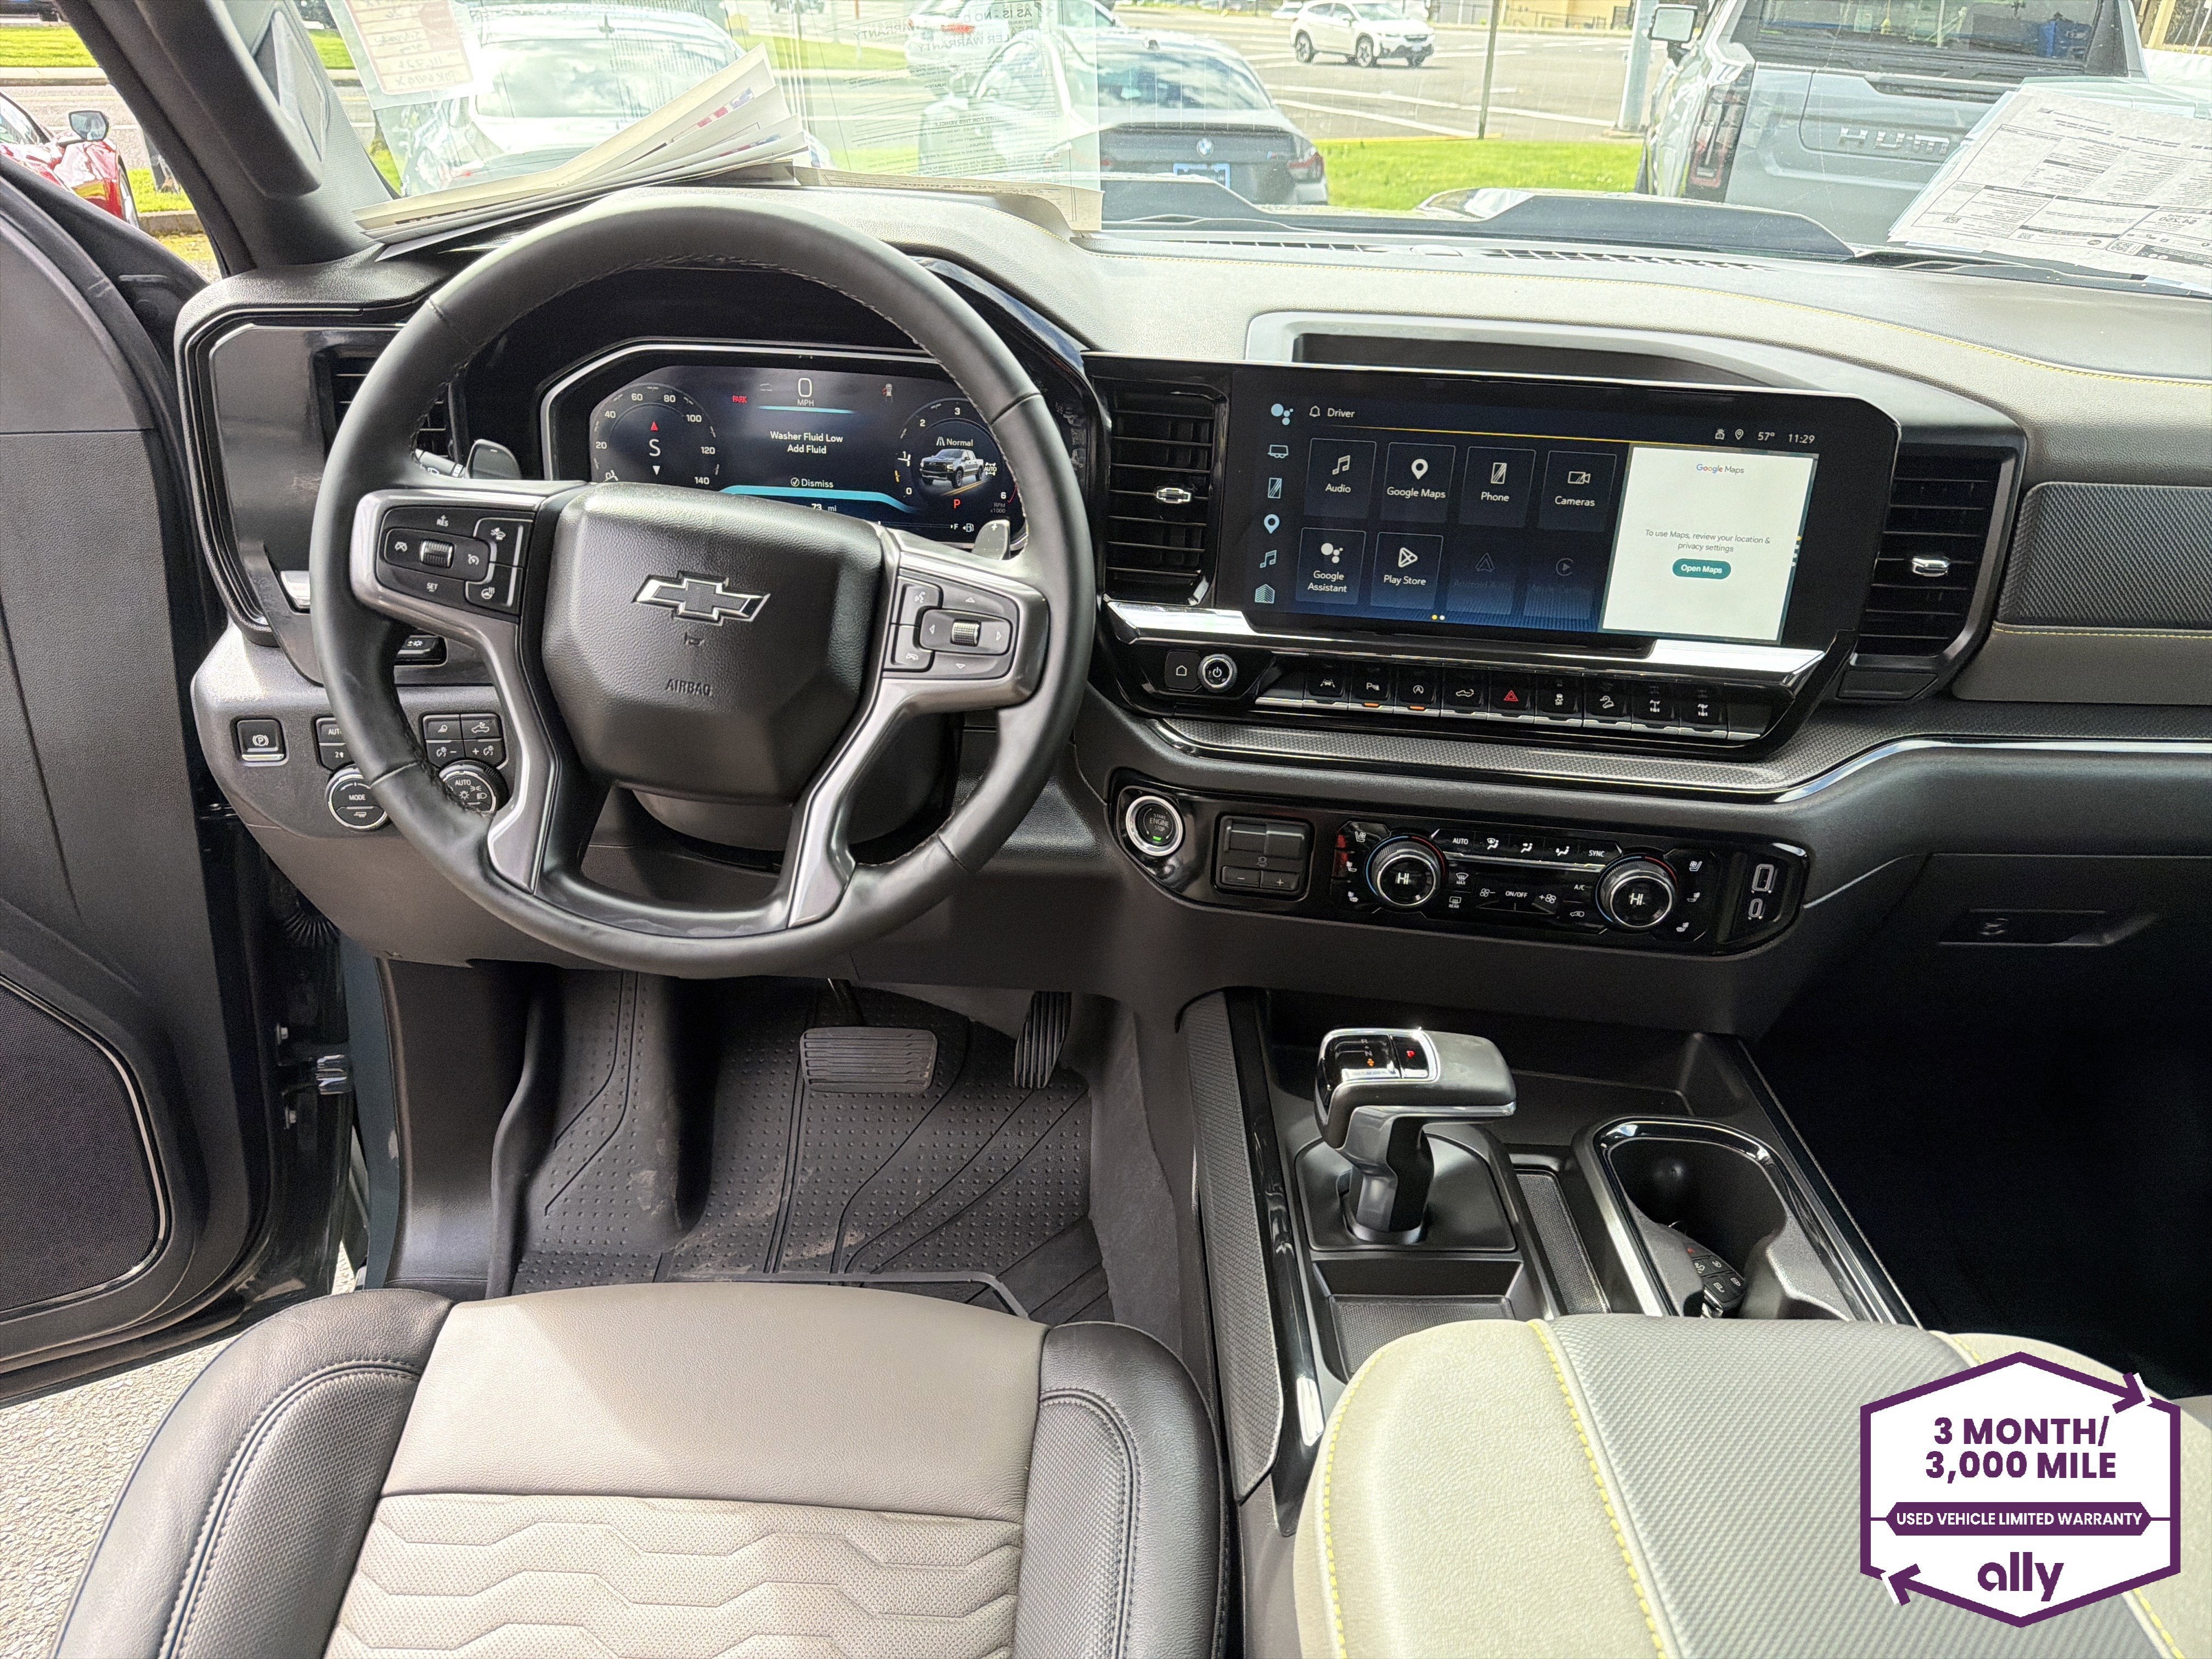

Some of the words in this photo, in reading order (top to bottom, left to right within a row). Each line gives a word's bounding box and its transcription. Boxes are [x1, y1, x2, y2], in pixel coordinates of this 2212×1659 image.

[798, 377, 812, 397] 0
[631, 393, 643, 401] 60
[664, 394, 676, 403] 80
[732, 395, 747, 403] PARK
[605, 410, 616, 419] 40
[954, 407, 961, 415] 3
[1327, 408, 1356, 420] Driver
[770, 431, 802, 441] Washer
[804, 432, 824, 442] Fluid
[826, 434, 843, 443] Low
[1757, 431, 1775, 442] 57°
[1787, 433, 1815, 444] 11:29
[595, 441, 607, 449] 20
[649, 439, 661, 456] S
[946, 438, 974, 447] Normal
[701, 446, 716, 454] 120
[787, 444, 804, 453] Add
[806, 445, 827, 454] Fluid
[1696, 463, 1724, 474] Google
[1724, 465, 1745, 475] Maps
[695, 477, 710, 485] 140
[801, 478, 834, 488] Dismiss
[1325, 483, 1351, 494] Audio
[1387, 487, 1419, 499] Google
[1421, 489, 1446, 500] Maps
[1481, 492, 1509, 502] Phone
[1555, 496, 1595, 507] Cameras
[953, 499, 961, 509] P
[437, 518, 449, 527] RES
[1645, 528, 1654, 537] To
[1669, 531, 1691, 541] Maps,
[1717, 535, 1734, 543] your
[1735, 534, 1763, 544] location
[1677, 542, 1704, 552] privacy
[1705, 543, 1734, 554] settings
[1680, 565, 1701, 574] Open
[1702, 565, 1723, 575] Maps
[1313, 570, 1345, 583] Google
[1384, 574, 1401, 586] Play
[1403, 575, 1426, 586] Store
[426, 582, 438, 590] SET
[1307, 582, 1347, 594] Assistant
[665, 678, 713, 697] AIRBAG
[1149, 817, 1170, 828] ENGINE
[1589, 849, 1605, 857] SYNC
[1397, 872, 1409, 885] HI
